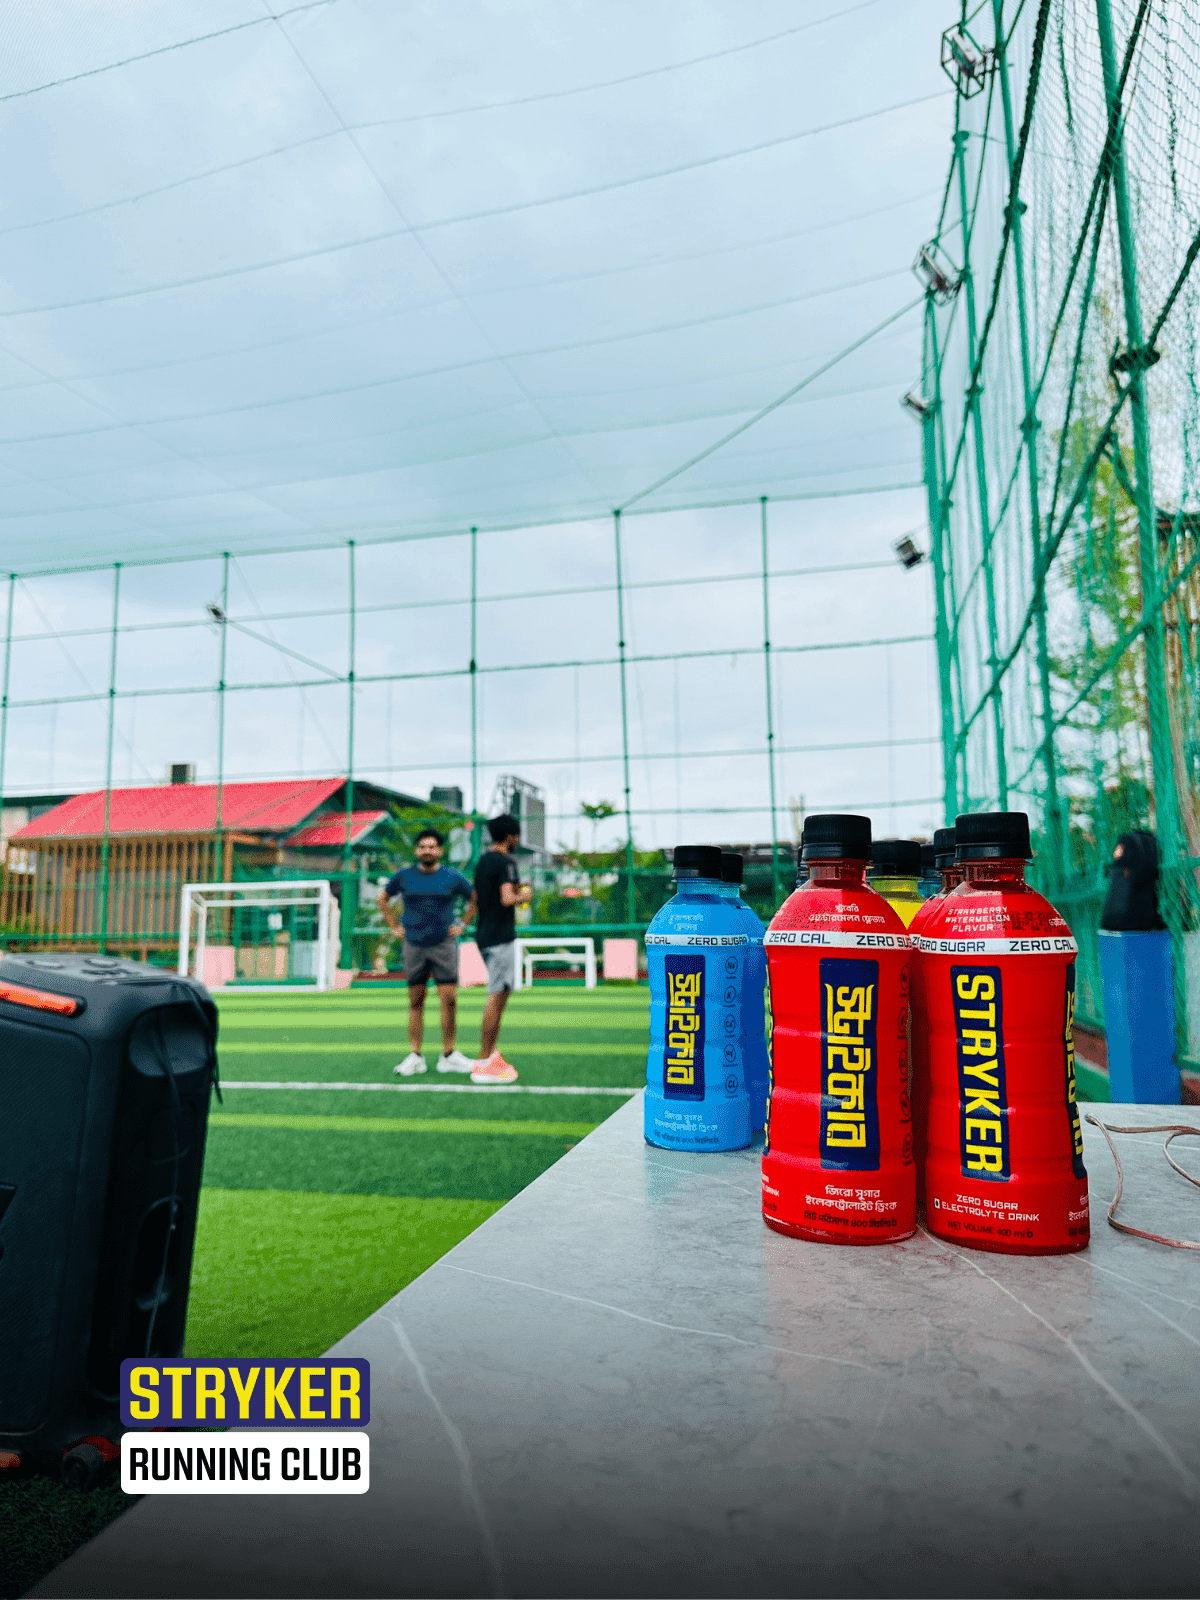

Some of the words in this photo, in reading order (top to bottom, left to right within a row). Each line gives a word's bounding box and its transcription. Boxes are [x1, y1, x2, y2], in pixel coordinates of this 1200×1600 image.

[948, 906, 1008, 916] STRAWBERRY
[945, 914, 1010, 924] WATERMELON
[952, 923, 994, 933] FLAVOR
[654, 936, 671, 945] CAL
[687, 936, 718, 946] ZERO
[769, 933, 797, 943] ZERO
[800, 934, 831, 944] CAL
[855, 935, 895, 947] ZERO
[940, 940, 986, 953] SUGAR
[1009, 940, 1051, 952] ZERO
[1054, 939, 1075, 951] CAL
[956, 974, 1003, 1172] STRYKER
[825, 1184, 853, 1197] জিরো
[855, 1189, 880, 1201] সুগার
[805, 1194, 873, 1213] ইলেকট্রোলাইট
[956, 1194, 981, 1206] ZERO
[983, 1199, 1018, 1210] SUGAR
[941, 1201, 1005, 1220] ELECTROLYTE
[1008, 1213, 1040, 1222] DRINK
[947, 1220, 962, 1231] NET
[997, 1227, 1012, 1238] 400
